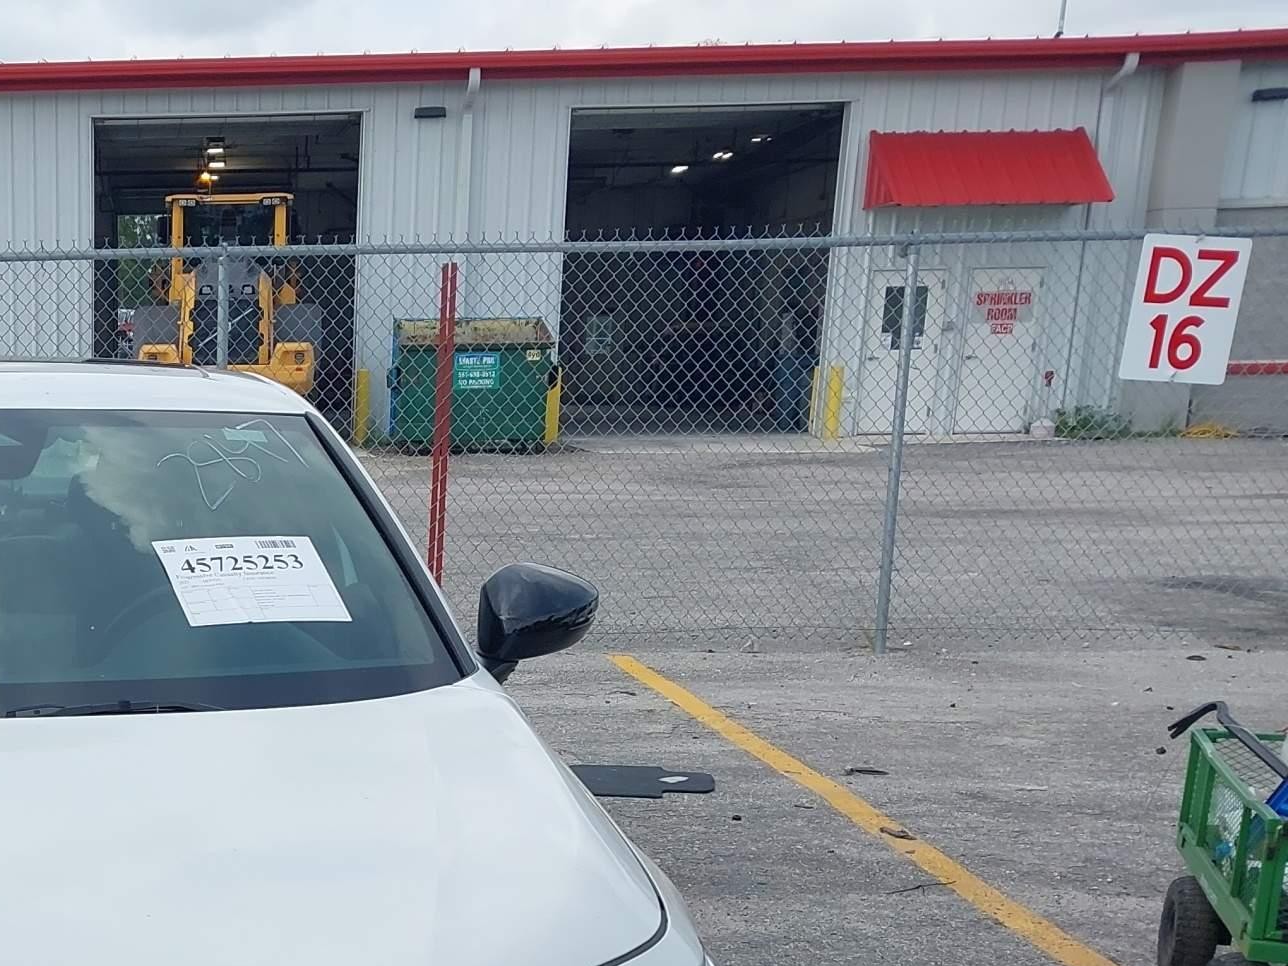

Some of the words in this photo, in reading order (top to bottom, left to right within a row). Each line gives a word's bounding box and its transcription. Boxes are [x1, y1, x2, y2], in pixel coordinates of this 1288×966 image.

[1142, 246, 1241, 309] DZ
[976, 292, 1032, 306] SPRINKLER
[986, 308, 1018, 321] ROOM
[1149, 314, 1205, 370] 16
[180, 555, 303, 574] 45725253
